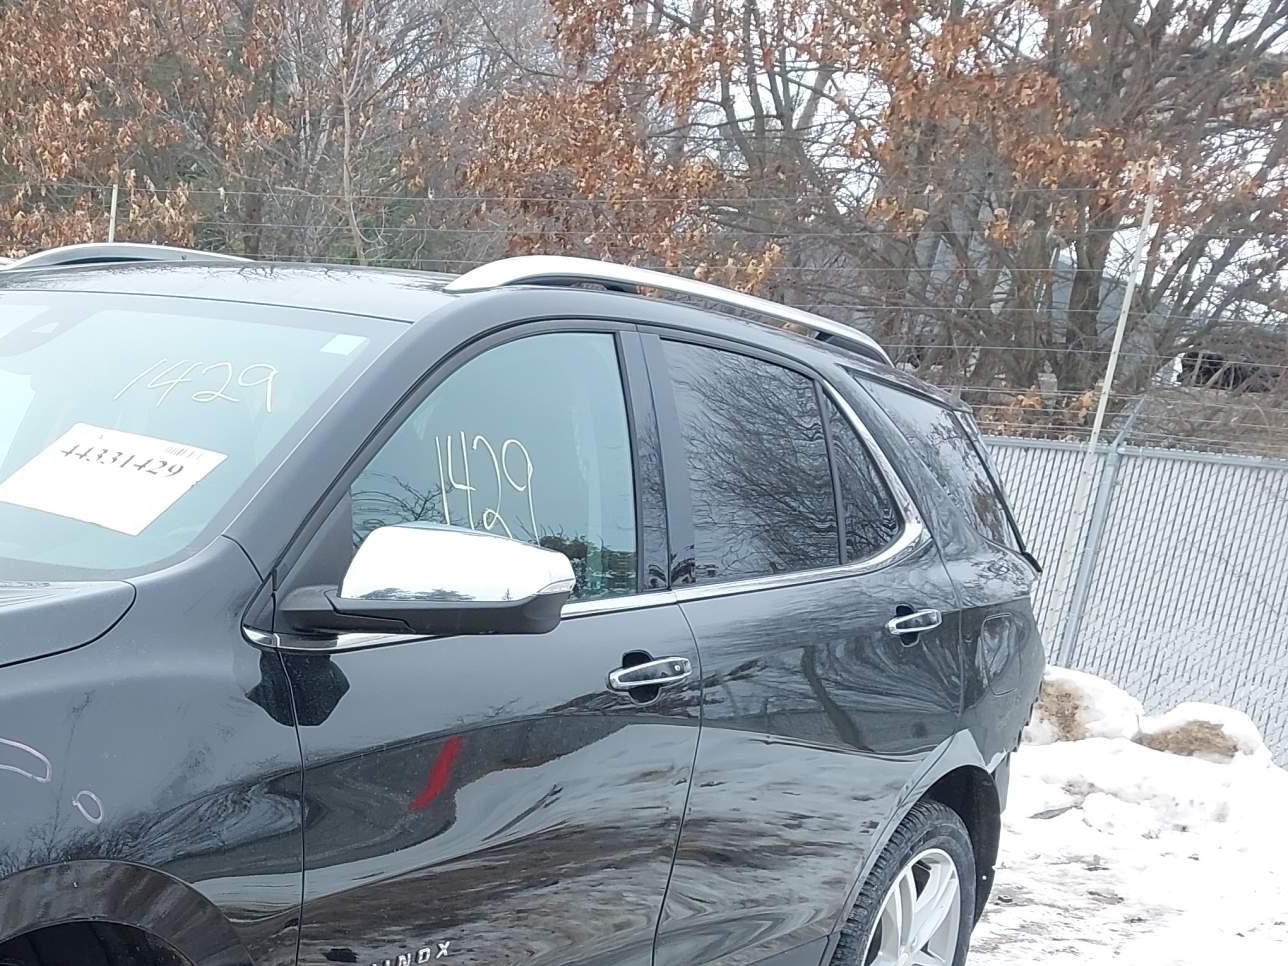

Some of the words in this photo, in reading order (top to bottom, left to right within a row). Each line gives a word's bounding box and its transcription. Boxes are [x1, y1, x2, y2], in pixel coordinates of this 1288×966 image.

[113, 358, 279, 413] 1429
[59, 443, 185, 478] 44331429
[435, 431, 541, 547] 1429
